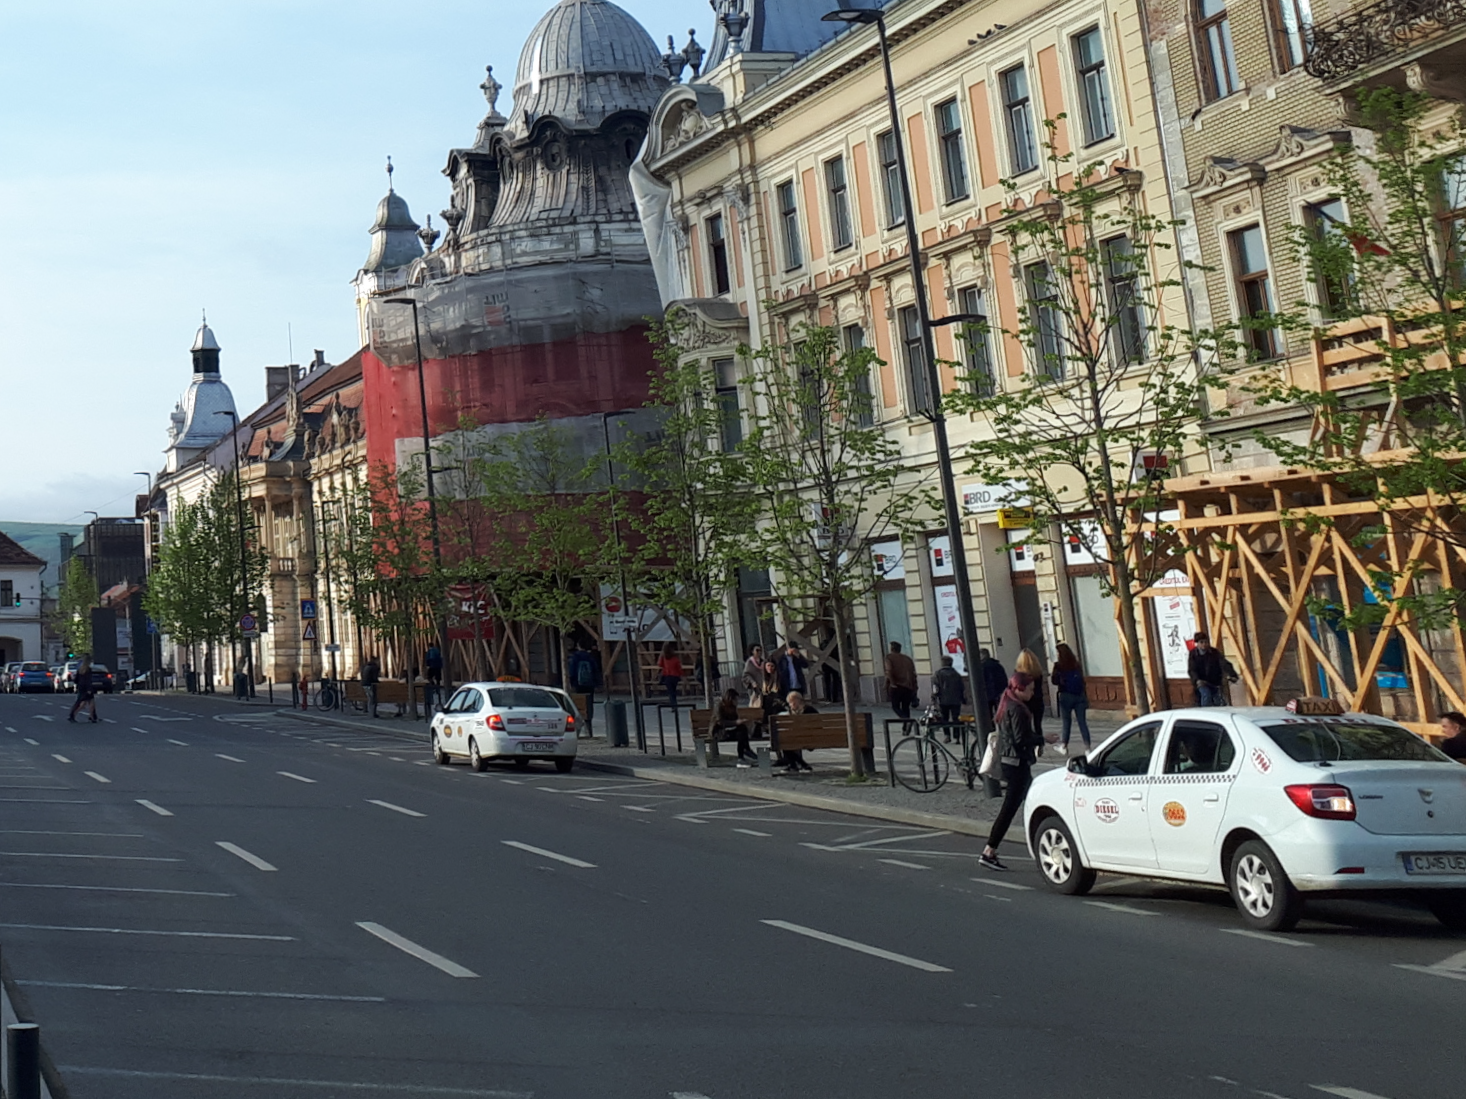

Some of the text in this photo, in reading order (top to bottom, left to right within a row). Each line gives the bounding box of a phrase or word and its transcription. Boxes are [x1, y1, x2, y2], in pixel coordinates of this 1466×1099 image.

[969, 491, 991, 505] BRD
[1303, 701, 1338, 712] TAXI
[1095, 805, 1118, 814] DIESEL
